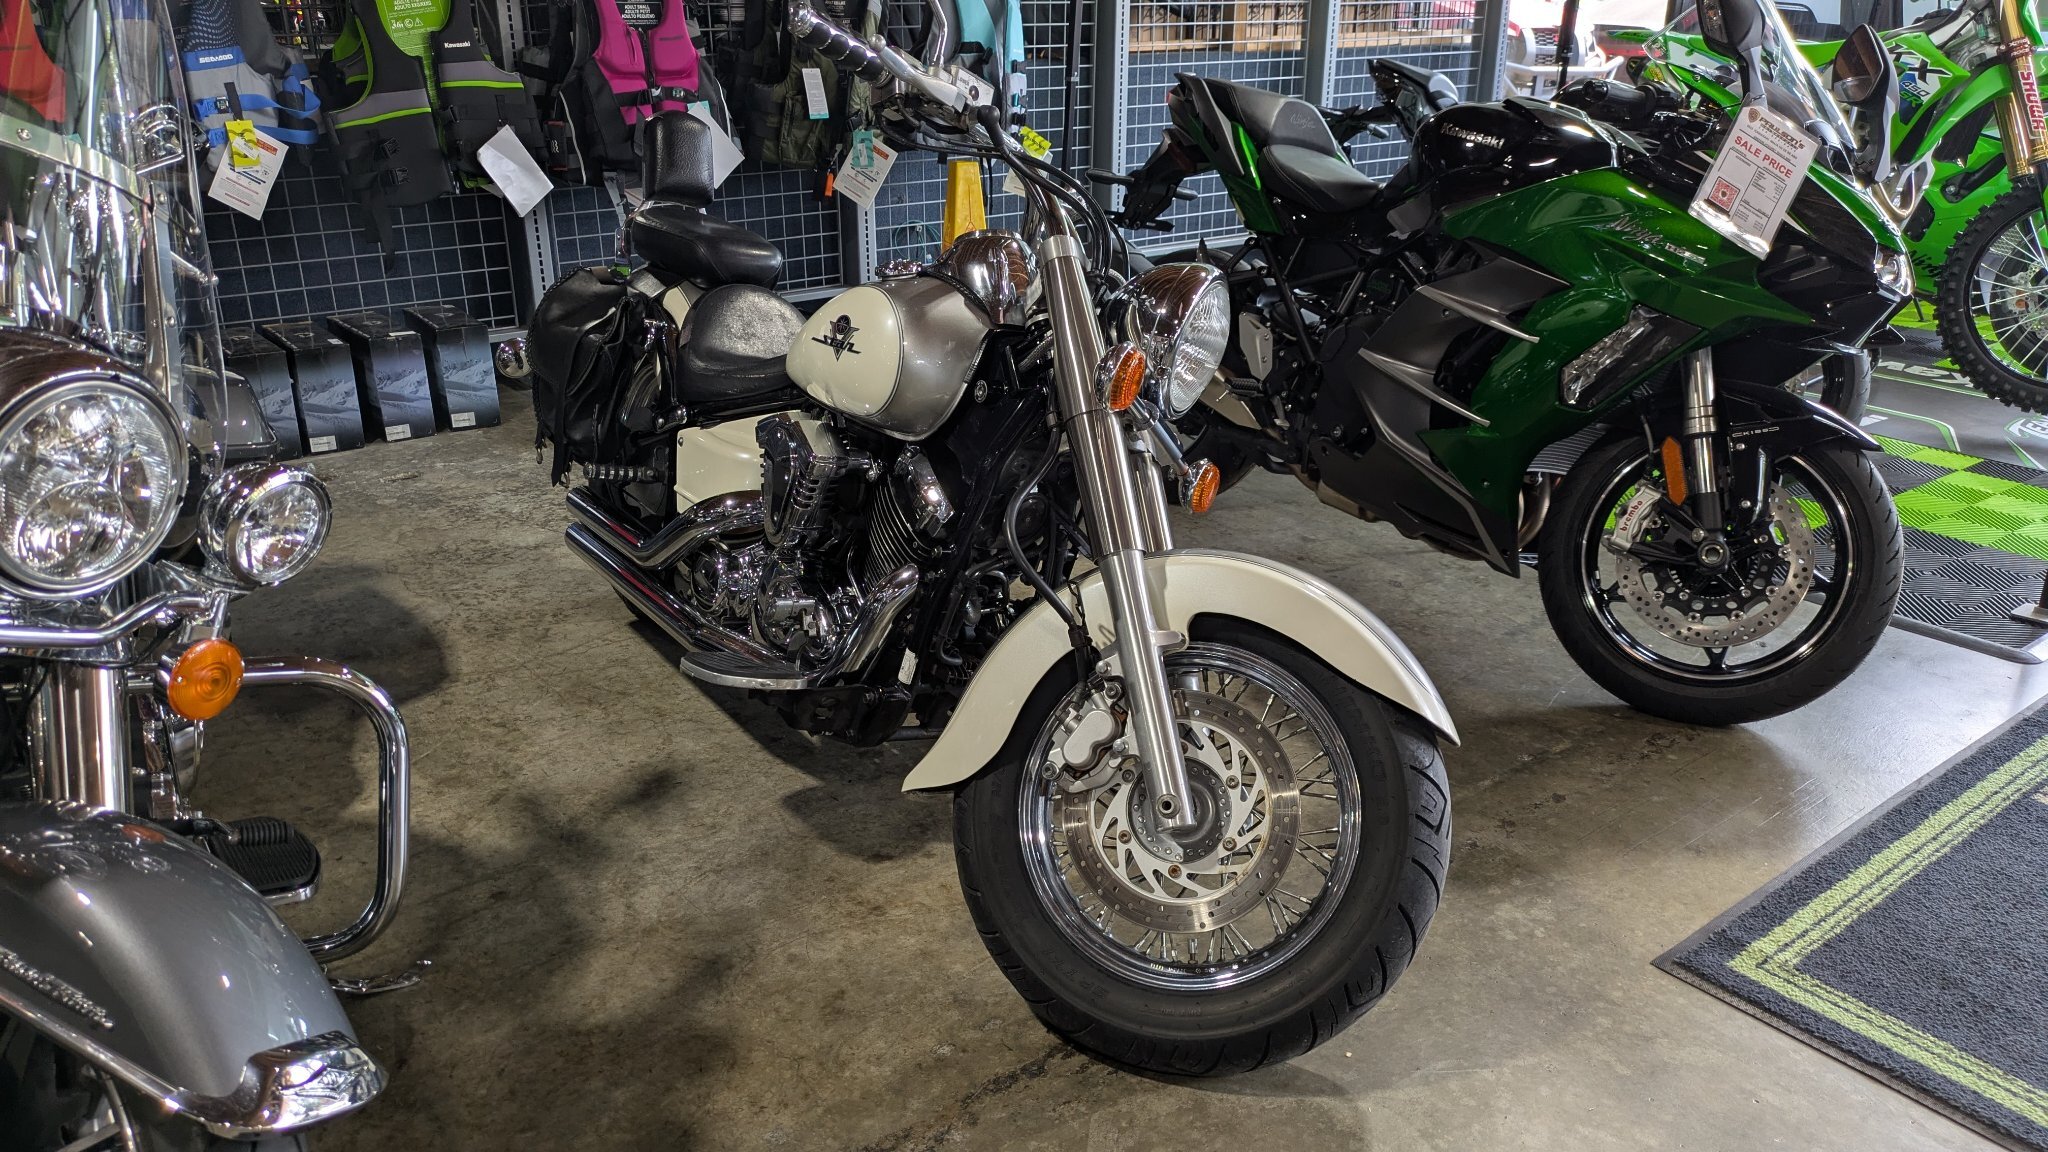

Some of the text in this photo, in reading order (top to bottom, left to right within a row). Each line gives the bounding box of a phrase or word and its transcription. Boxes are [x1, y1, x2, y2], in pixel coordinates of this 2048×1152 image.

[444, 41, 471, 49] Kawasaki
[1901, 81, 1931, 97] 450
[2018, 71, 2047, 131] SHOWA
[1441, 122, 1506, 149] Kawasaki
[1734, 135, 1762, 158] SALE
[1762, 154, 1794, 178] PRICE
[1620, 500, 1643, 532] brembo
